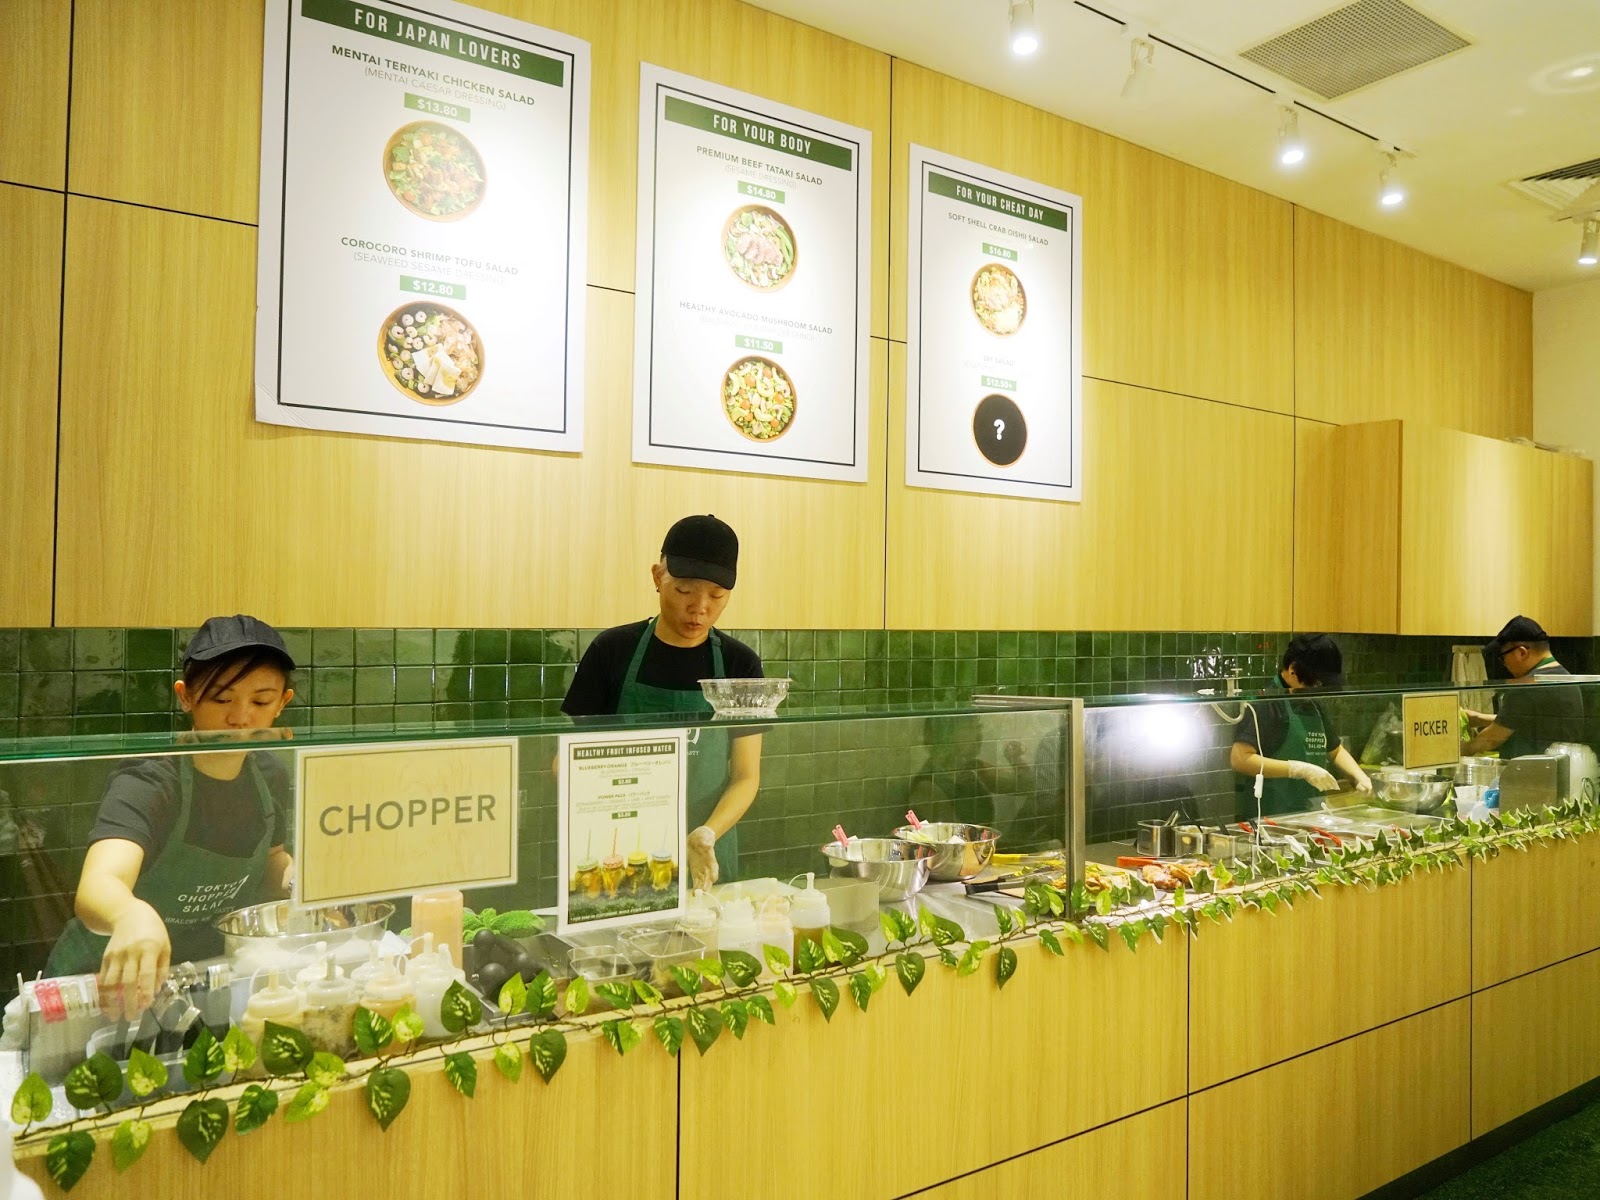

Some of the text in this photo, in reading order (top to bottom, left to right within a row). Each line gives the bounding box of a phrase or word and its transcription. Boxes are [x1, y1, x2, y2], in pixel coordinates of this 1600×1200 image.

[354, 8, 521, 70] FOR JAPAN LOVERS
[332, 44, 535, 106] MENTAI TERIYAKI CHICKEN SALAD
[364, 66, 506, 111] (MENTAI CAESAR DRESSING)
[417, 98, 458, 118] $13.80
[713, 114, 811, 155] FOR YOUR BODY
[696, 145, 823, 186] PREMIUM BEEF TATAKI SALAD
[746, 185, 776, 200] $14.80
[956, 184, 1044, 221] FOR YOUR CHEAT DAY
[948, 212, 1049, 246] SOFT SHELL CRAB OISHII SALAD
[341, 237, 519, 275] COROCORO SHRIMP TOFU SALAD
[353, 251, 409, 269] (SEAWEED
[411, 261, 451, 276] SESAME
[412, 280, 454, 296] $12.80
[679, 300, 717, 314] HEALTHY
[718, 307, 759, 321] AVOCADO
[761, 315, 807, 330] MUSHROOM
[808, 323, 833, 335] SALAD
[744, 337, 774, 351] $11.50
[993, 418, 1005, 441] ?
[1413, 719, 1448, 737] PICKER
[576, 744, 673, 758] HEALTHY FRUIT INFUSED WATER
[319, 793, 497, 838] CHOPPER
[195, 881, 238, 894] TOKYO
